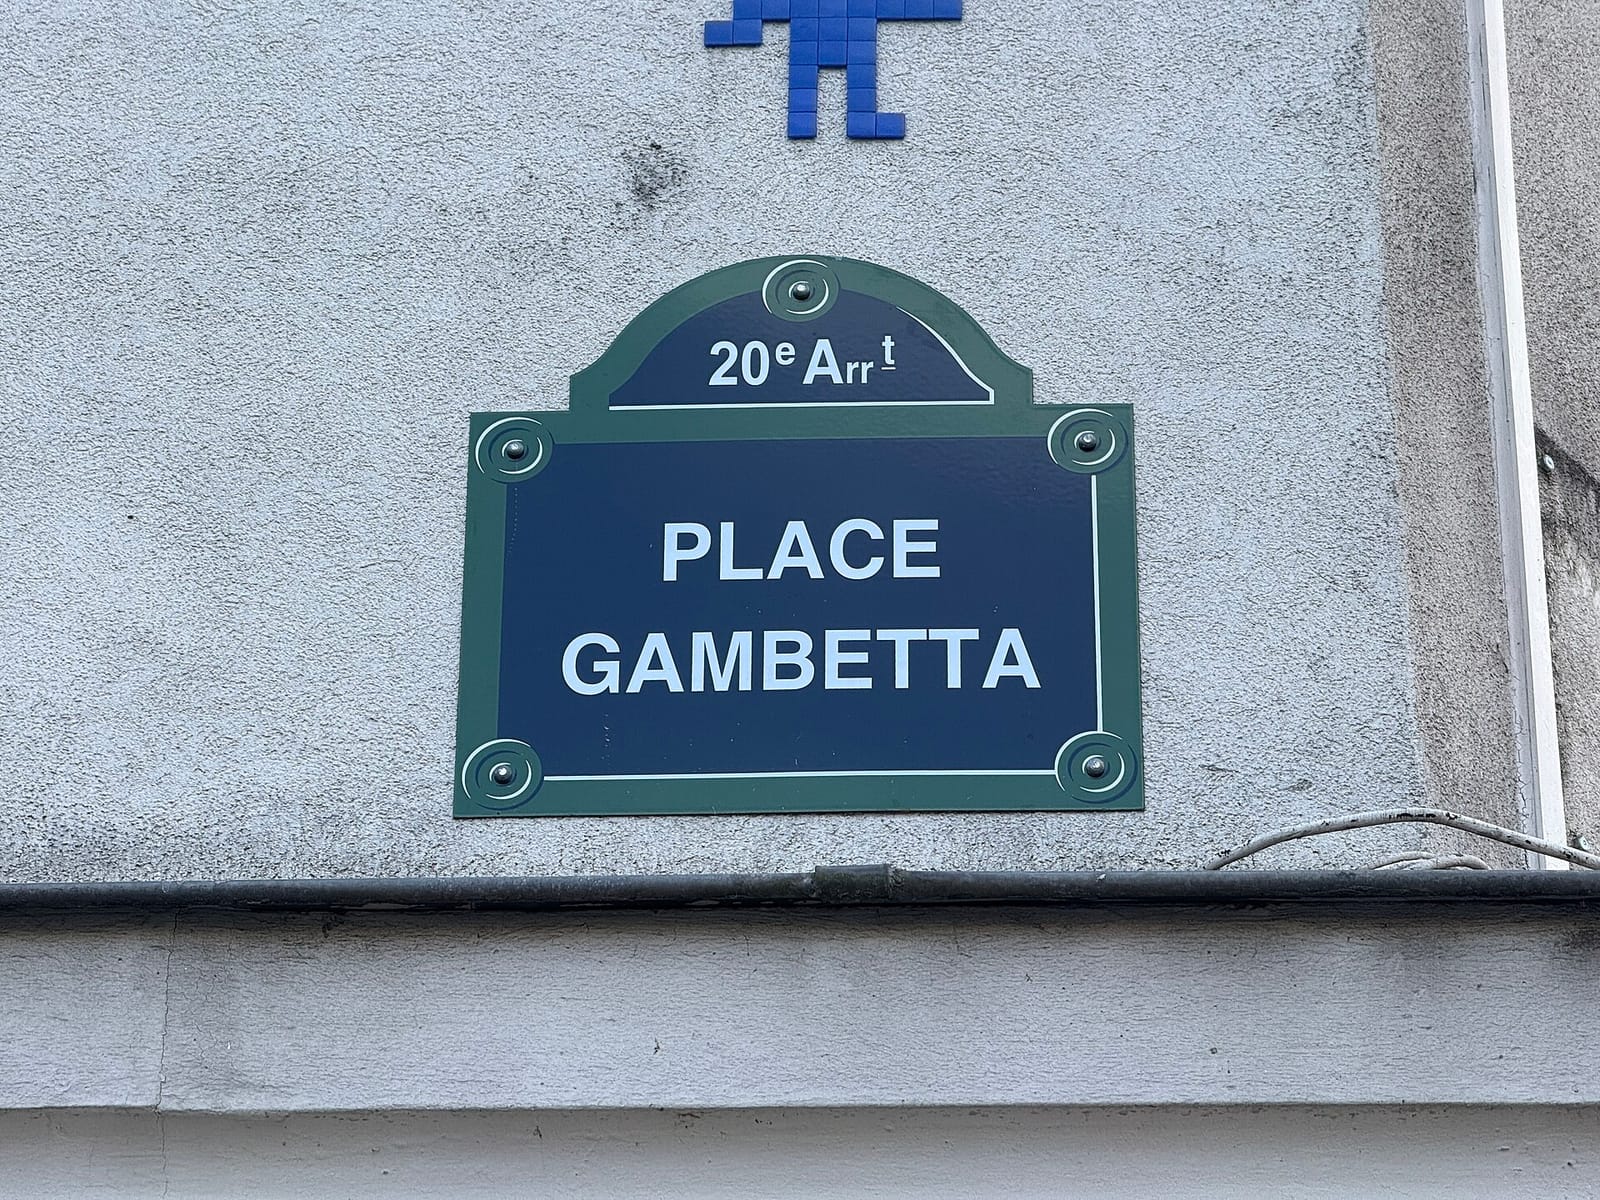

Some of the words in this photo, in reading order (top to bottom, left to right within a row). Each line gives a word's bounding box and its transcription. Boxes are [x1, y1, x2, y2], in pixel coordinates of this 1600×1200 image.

[708, 340, 796, 386] 20e
[663, 518, 941, 582] PLACE
[562, 628, 1042, 696] GAMBETTA
